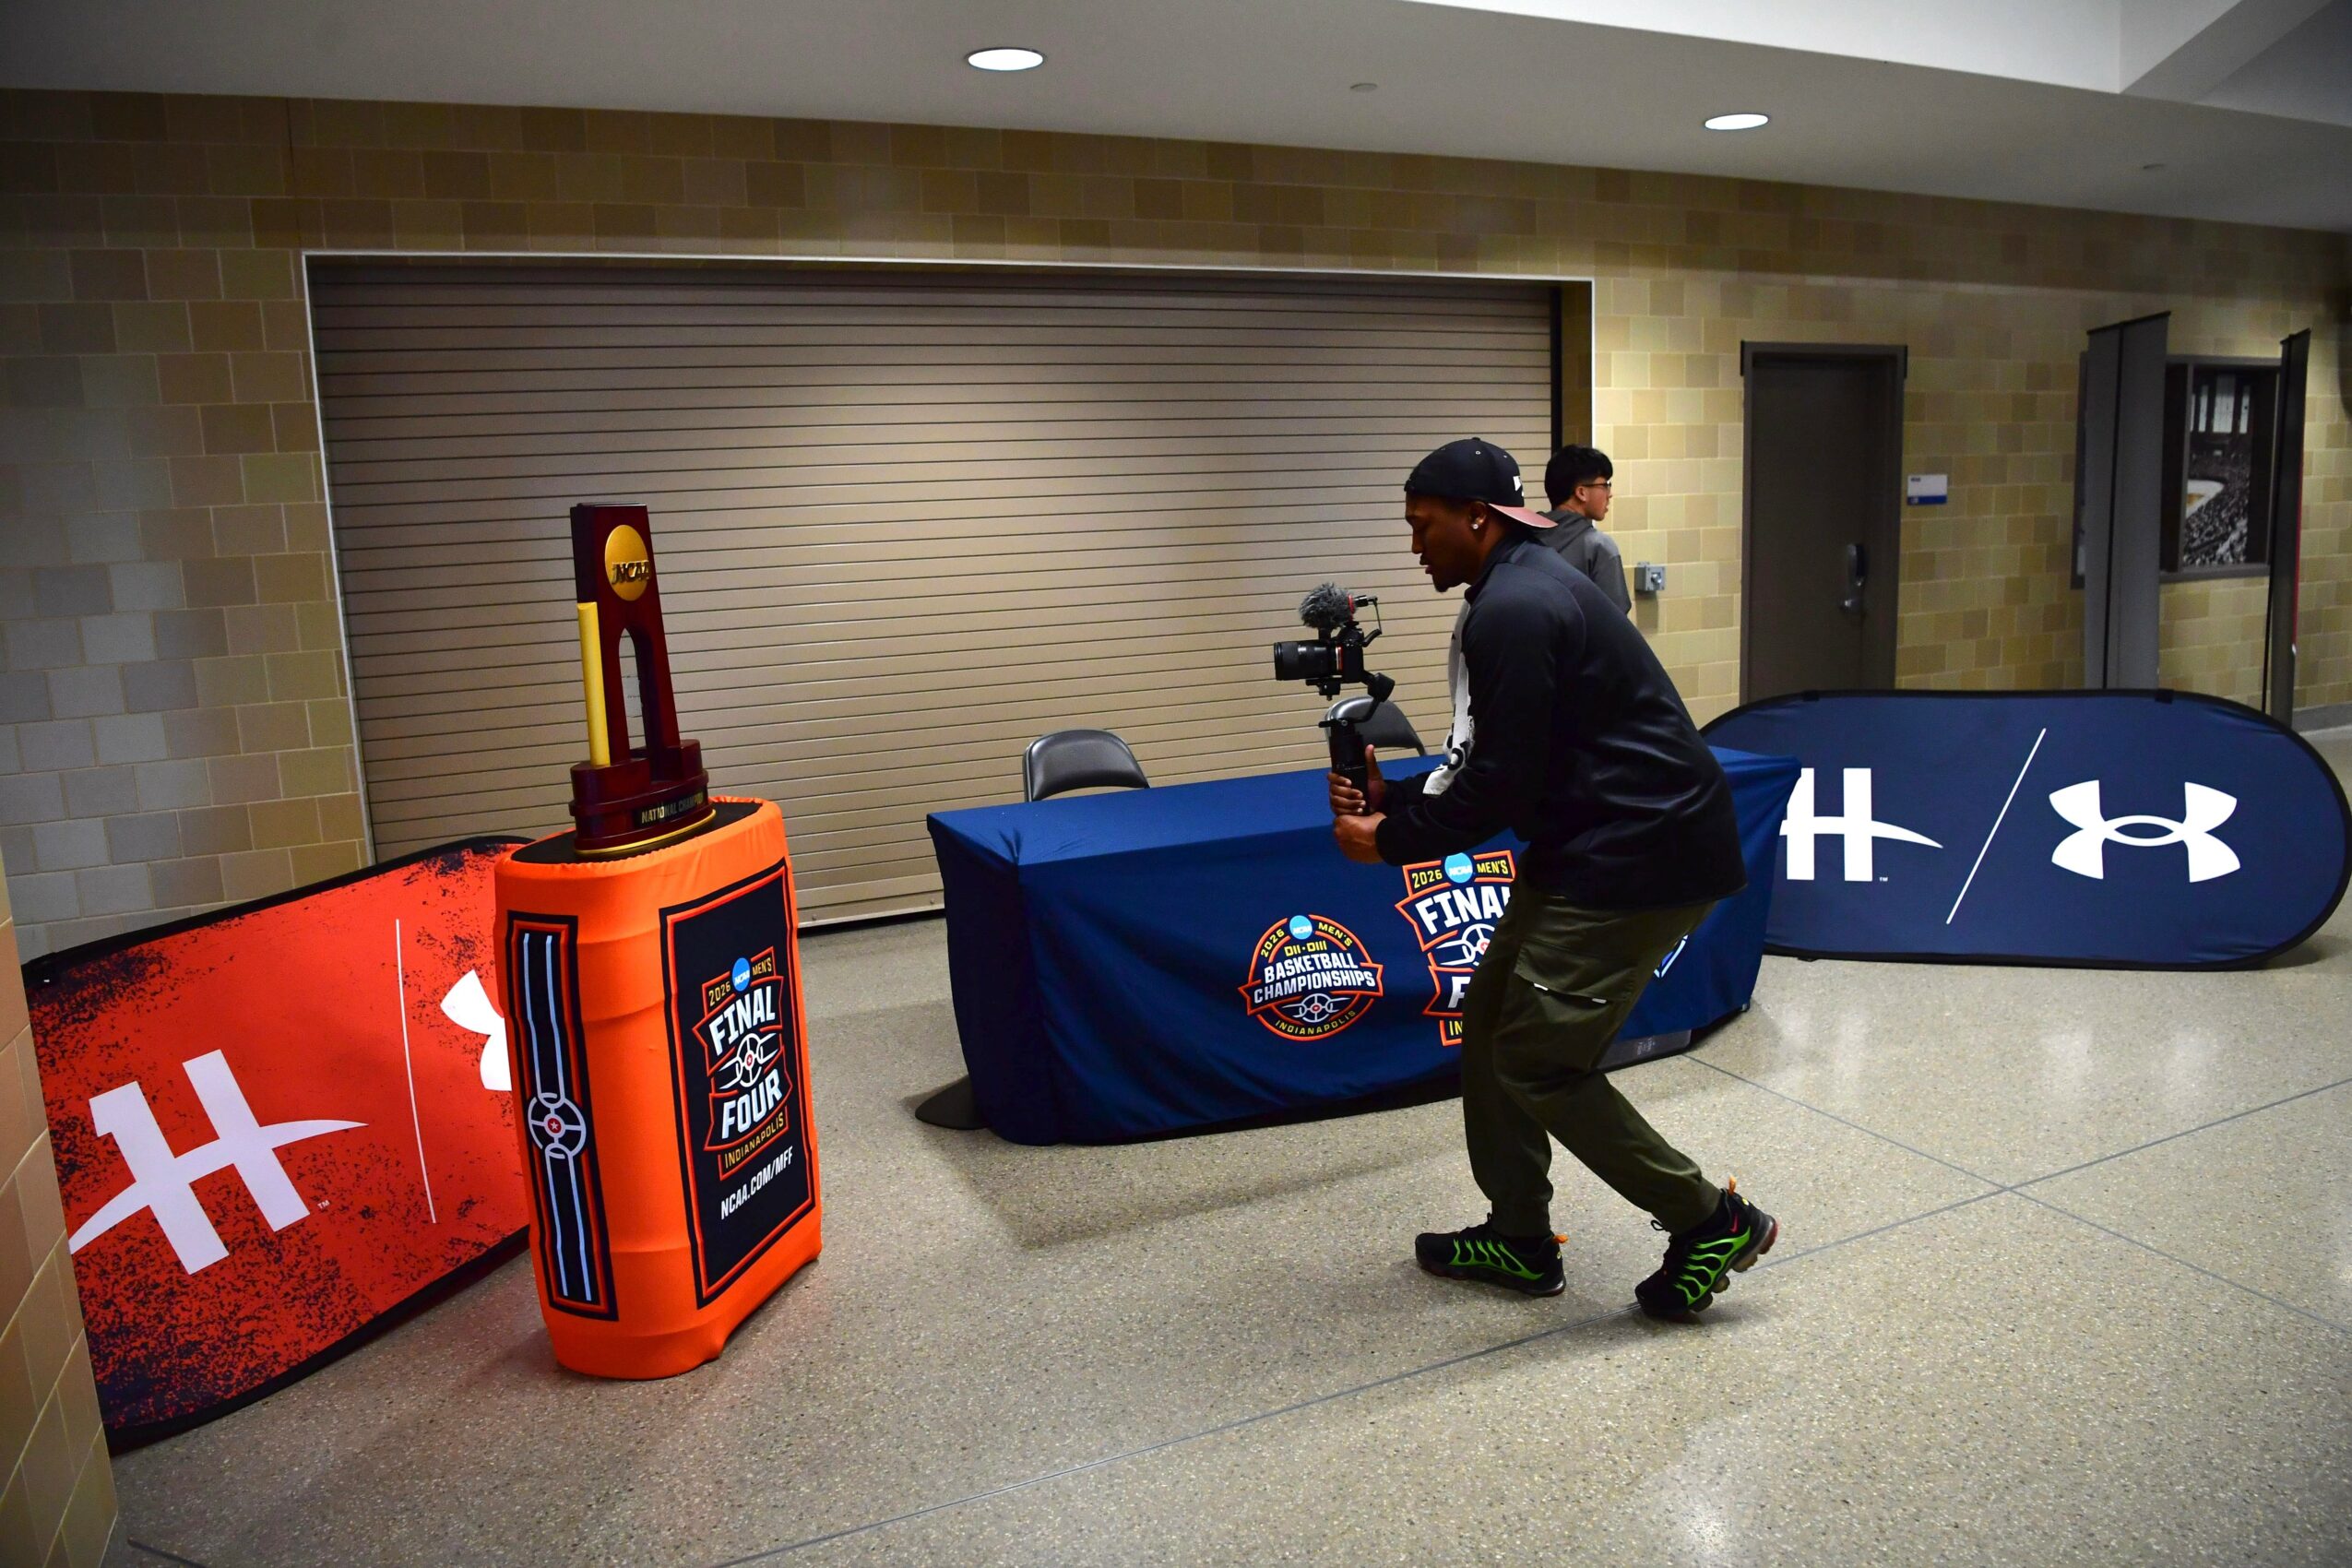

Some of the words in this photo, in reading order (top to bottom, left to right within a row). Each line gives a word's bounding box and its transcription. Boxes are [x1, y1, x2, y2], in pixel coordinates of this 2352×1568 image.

[611, 560, 650, 584] NCAA
[641, 802, 677, 824] NATIONAL
[1411, 869, 1443, 888] 2026
[1476, 860, 1509, 874] MEN'S
[1260, 928, 1286, 958] 2026
[1318, 922, 1353, 946] MEN'S
[708, 980, 731, 1007] 2026
[734, 969, 751, 986] NCAA
[752, 956, 772, 976] MEN'S
[1264, 952, 1359, 984] BASKETBALL
[1253, 969, 1376, 1004] CHAMPIONSHIPS
[708, 985, 776, 1056] FINAL
[1275, 1010, 1357, 1035] INDIANAPOLIS
[721, 1068, 782, 1139] FOUR
[724, 1111, 784, 1170] INDIANAPOLIS
[720, 1146, 793, 1220] NCAA.COM/MFF
